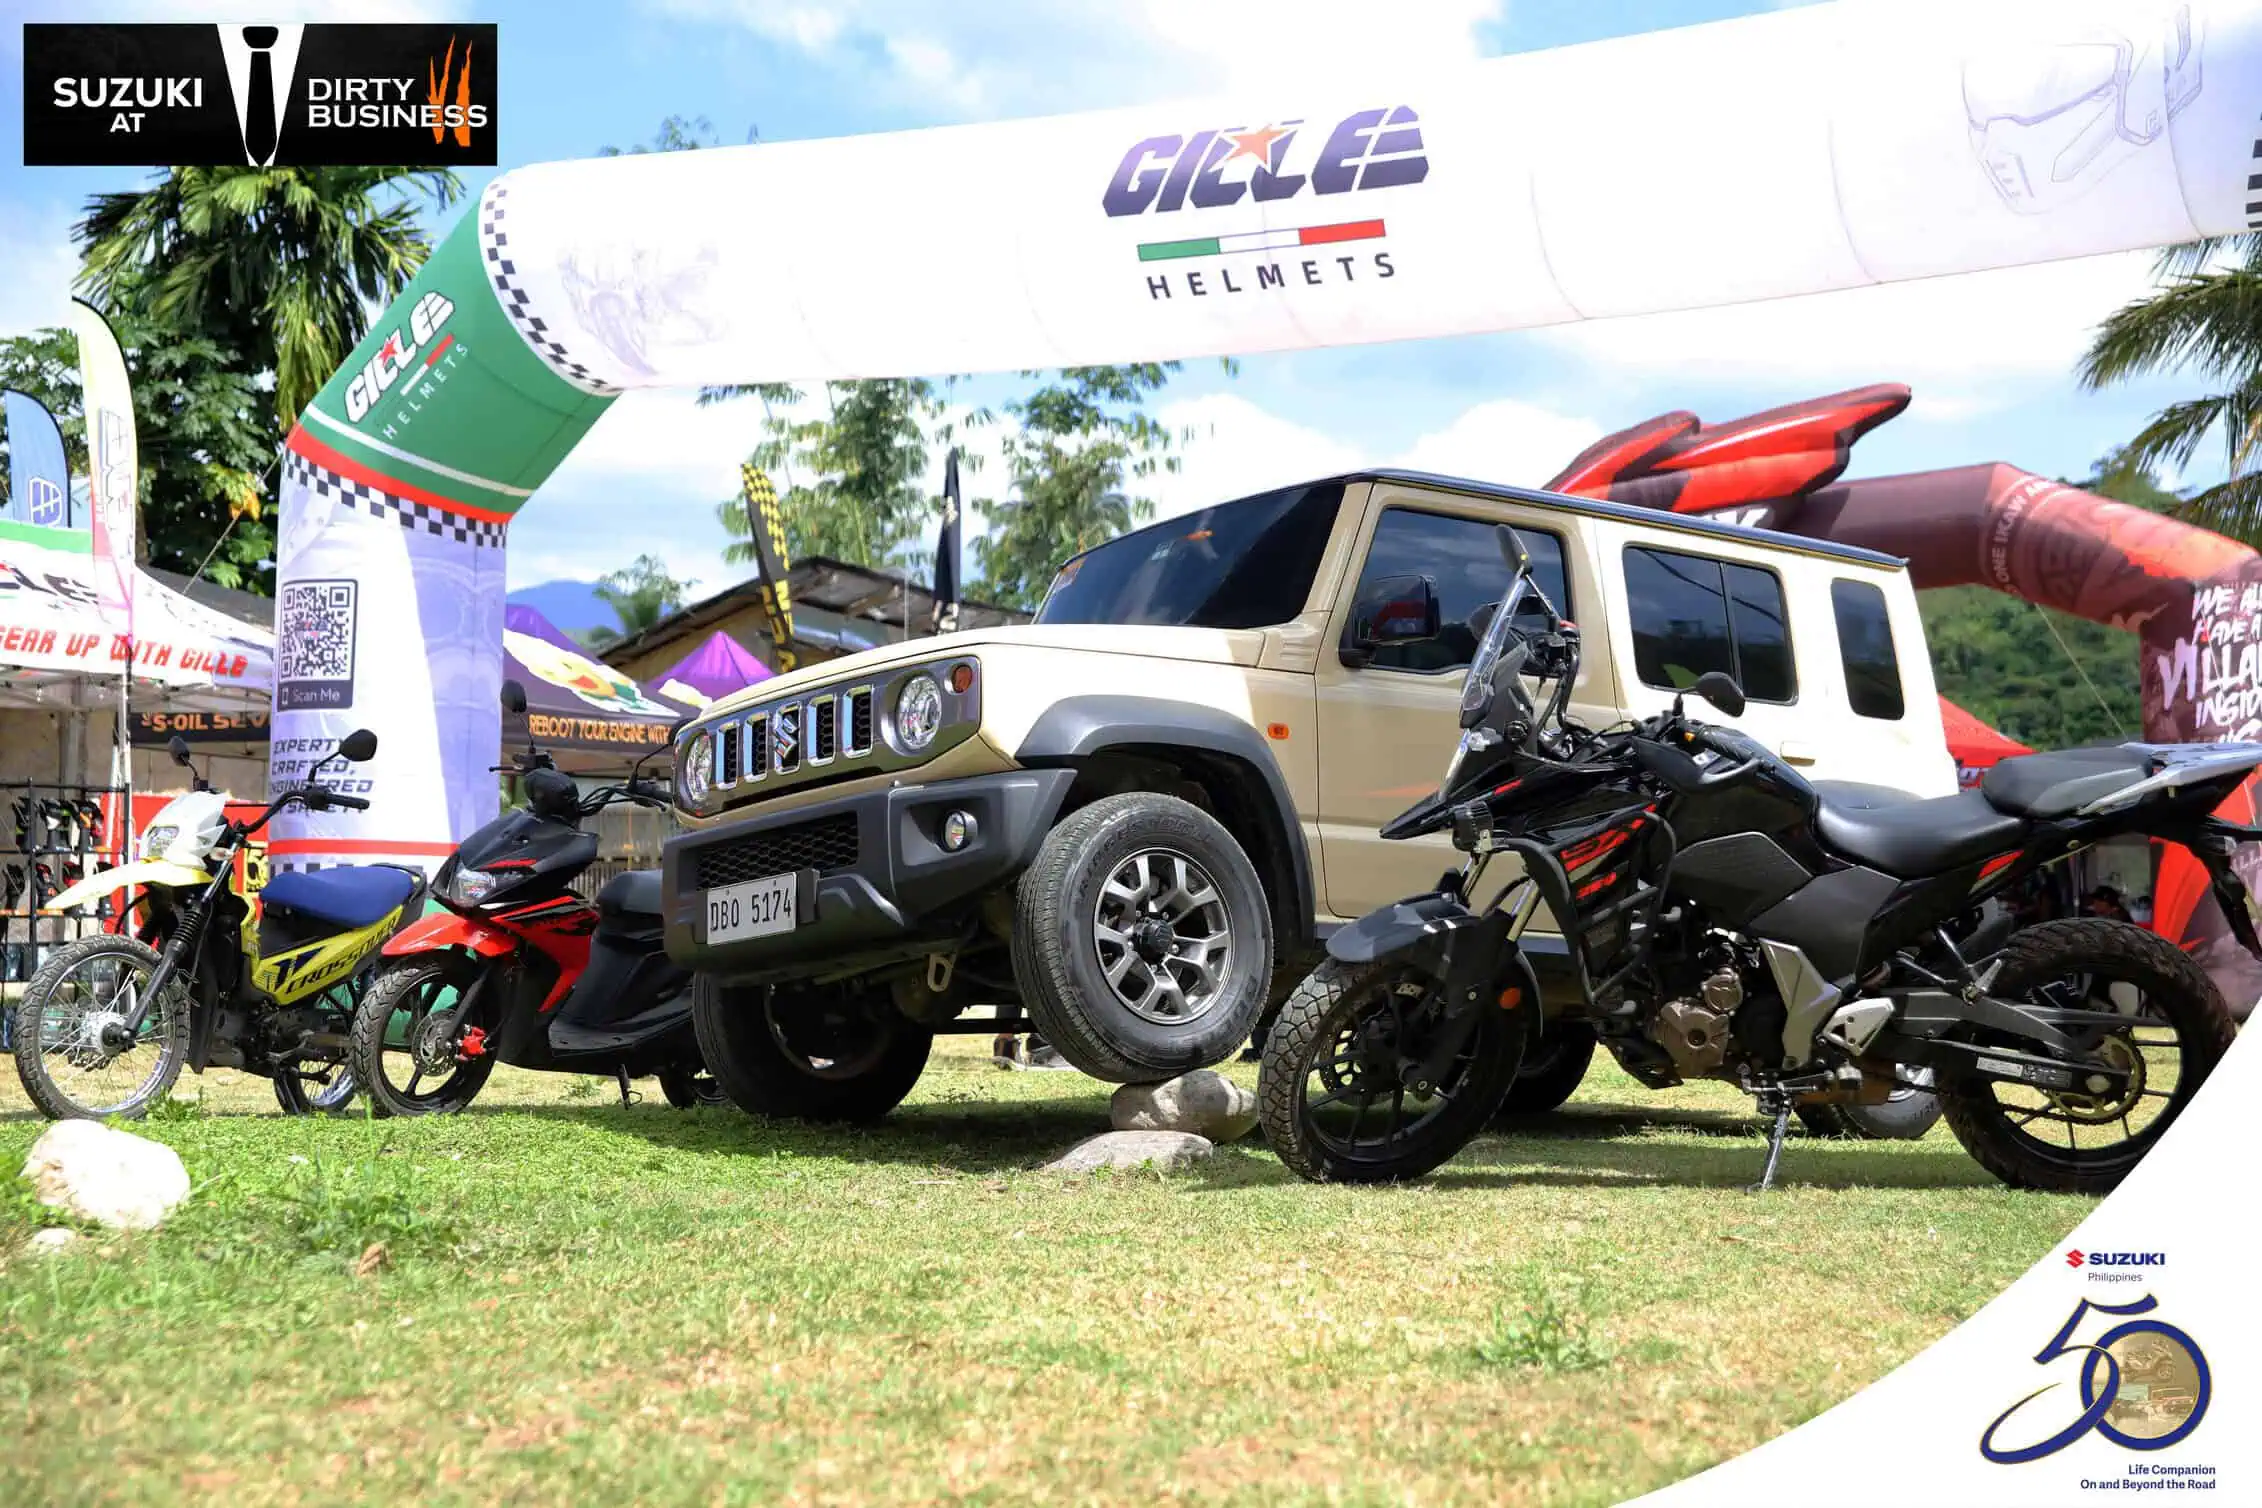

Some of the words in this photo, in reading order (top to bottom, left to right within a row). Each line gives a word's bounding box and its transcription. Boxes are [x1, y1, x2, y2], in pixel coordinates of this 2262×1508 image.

[1102, 104, 1430, 218] GILLE
[1146, 252, 1396, 300] HELMETS
[344, 290, 456, 425] GILLE
[382, 343, 469, 440] HELMETS
[2192, 584, 2235, 621] WE
[65, 633, 100, 659] UP
[109, 633, 174, 668] WITH
[2192, 615, 2249, 645] HAVE
[292, 689, 317, 703] Scan
[320, 688, 341, 702] Me
[2157, 638, 2262, 711] VILLA
[528, 714, 576, 738] REBOOT
[577, 719, 608, 741] YOUR
[608, 722, 647, 744] ENGINE
[2196, 690, 2262, 728] INSID
[710, 897, 740, 933] DBO
[751, 887, 791, 925] 5174
